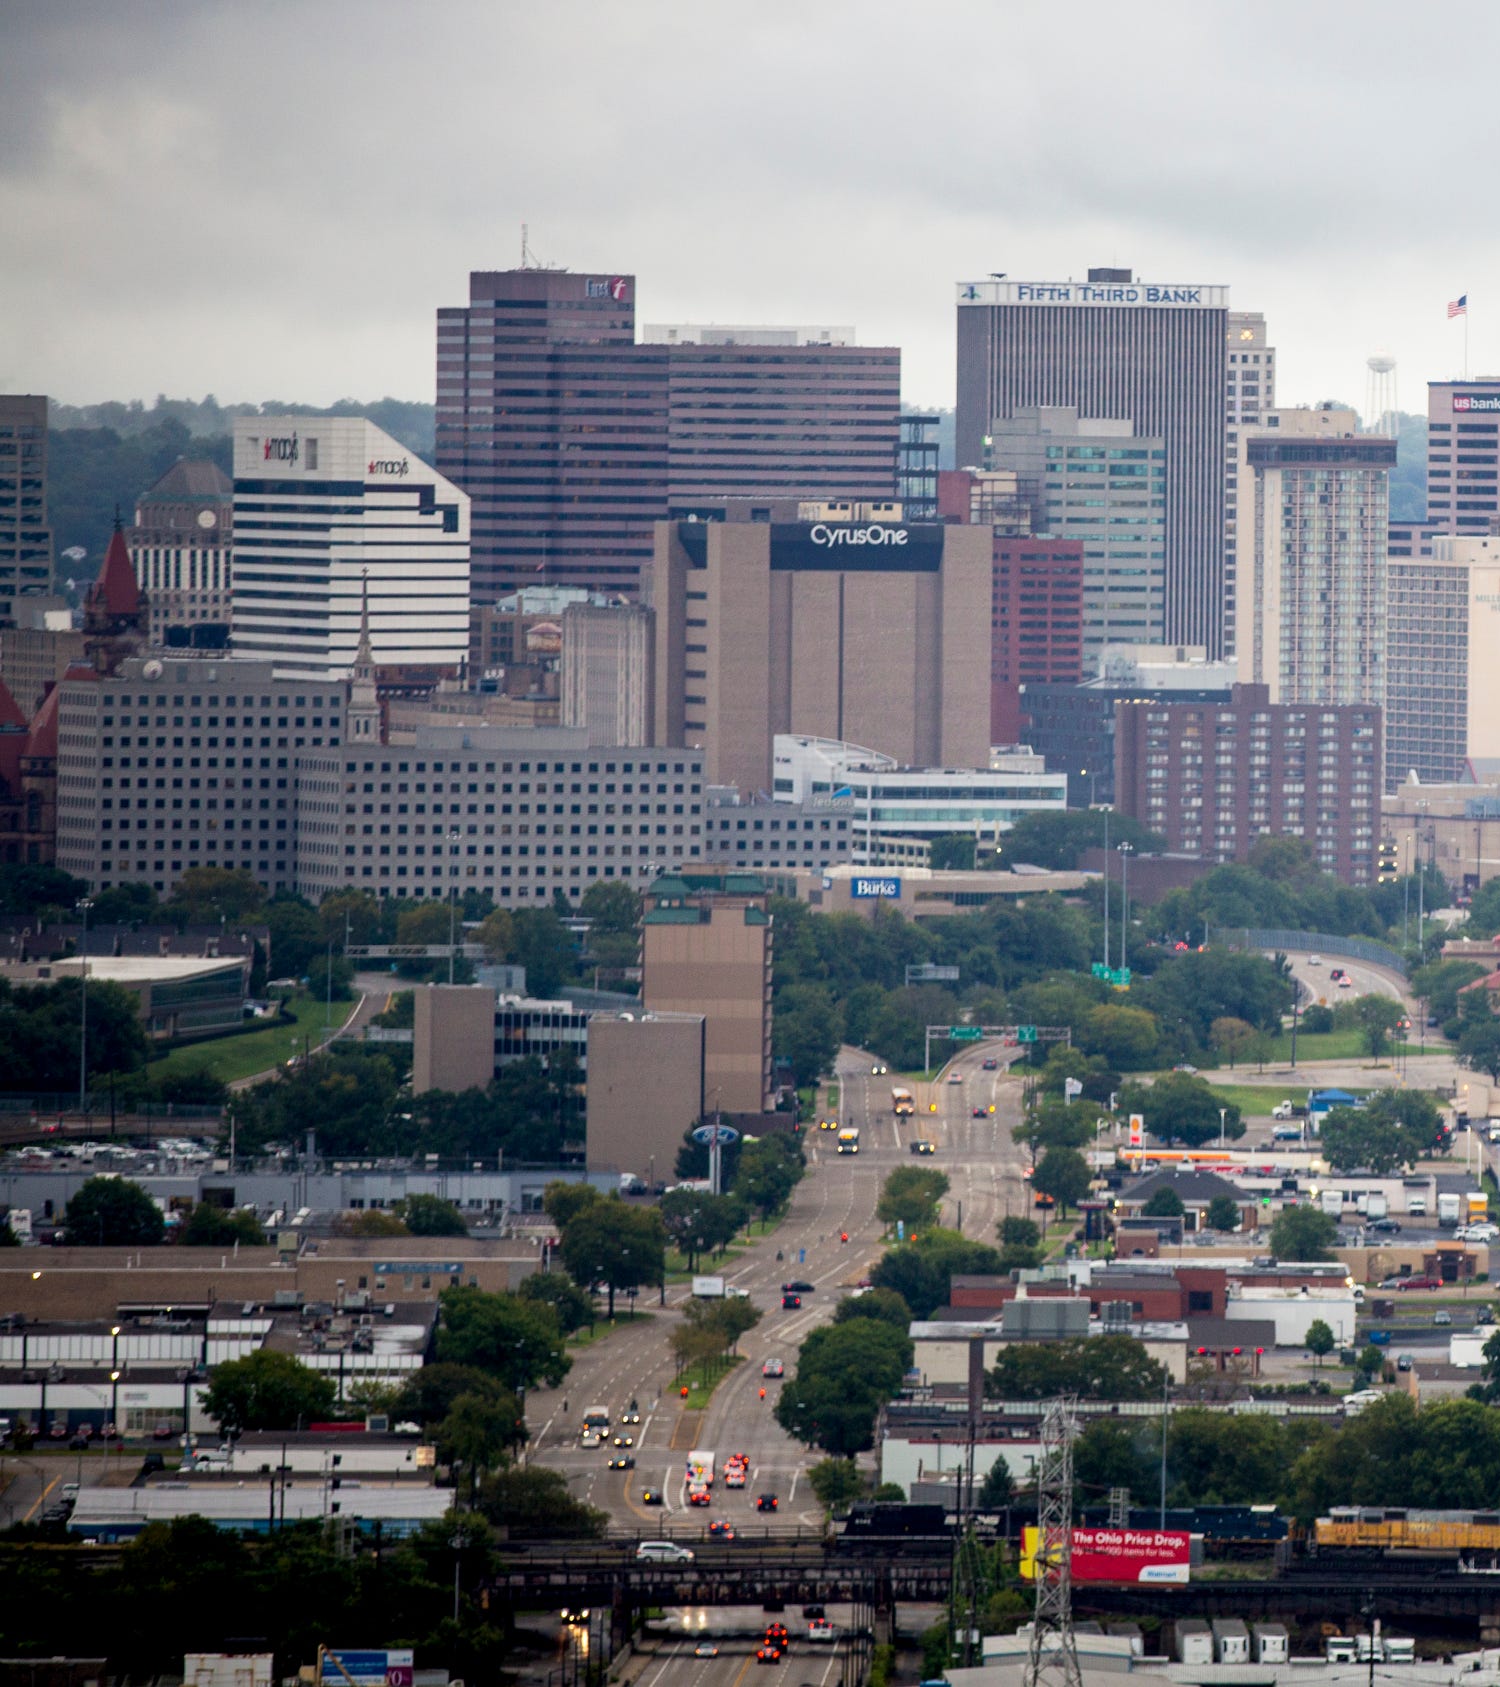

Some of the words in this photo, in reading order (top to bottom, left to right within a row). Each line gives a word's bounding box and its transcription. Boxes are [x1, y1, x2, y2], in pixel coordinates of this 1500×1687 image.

[1018, 285, 1070, 301] FIFTH
[1078, 286, 1139, 302] THIRD
[1147, 288, 1200, 303] BANK
[810, 524, 909, 548] CyrusOne
[857, 879, 896, 896] Burke
[1073, 1531, 1093, 1544] The
[1095, 1531, 1123, 1545] Ohio
[1125, 1532, 1154, 1546] Price
